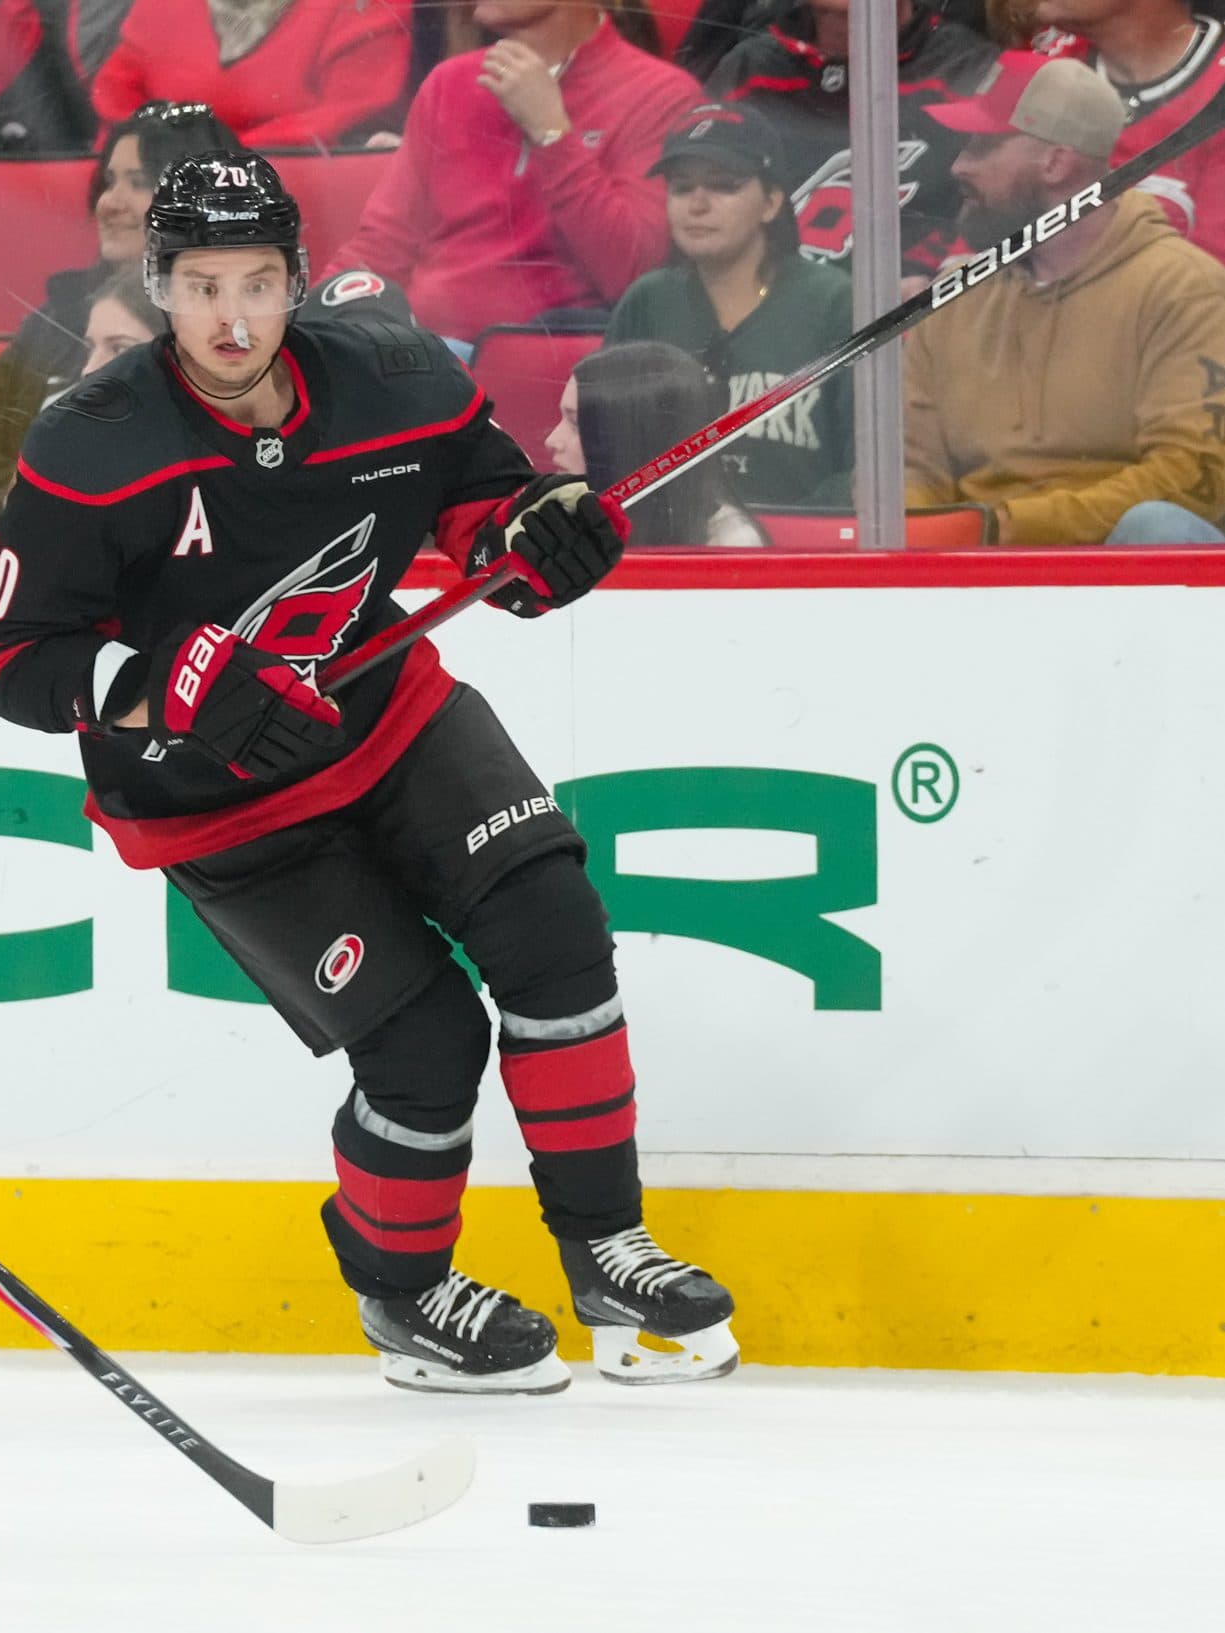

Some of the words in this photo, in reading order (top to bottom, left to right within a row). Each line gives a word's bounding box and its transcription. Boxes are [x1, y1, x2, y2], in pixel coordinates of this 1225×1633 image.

[213, 165, 248, 187] 20
[351, 462, 421, 484] NUCOR
[608, 426, 721, 501] YPERLITE
[173, 485, 214, 557] A
[174, 623, 232, 708] BAU
[99, 1371, 200, 1450] FLYLITE
